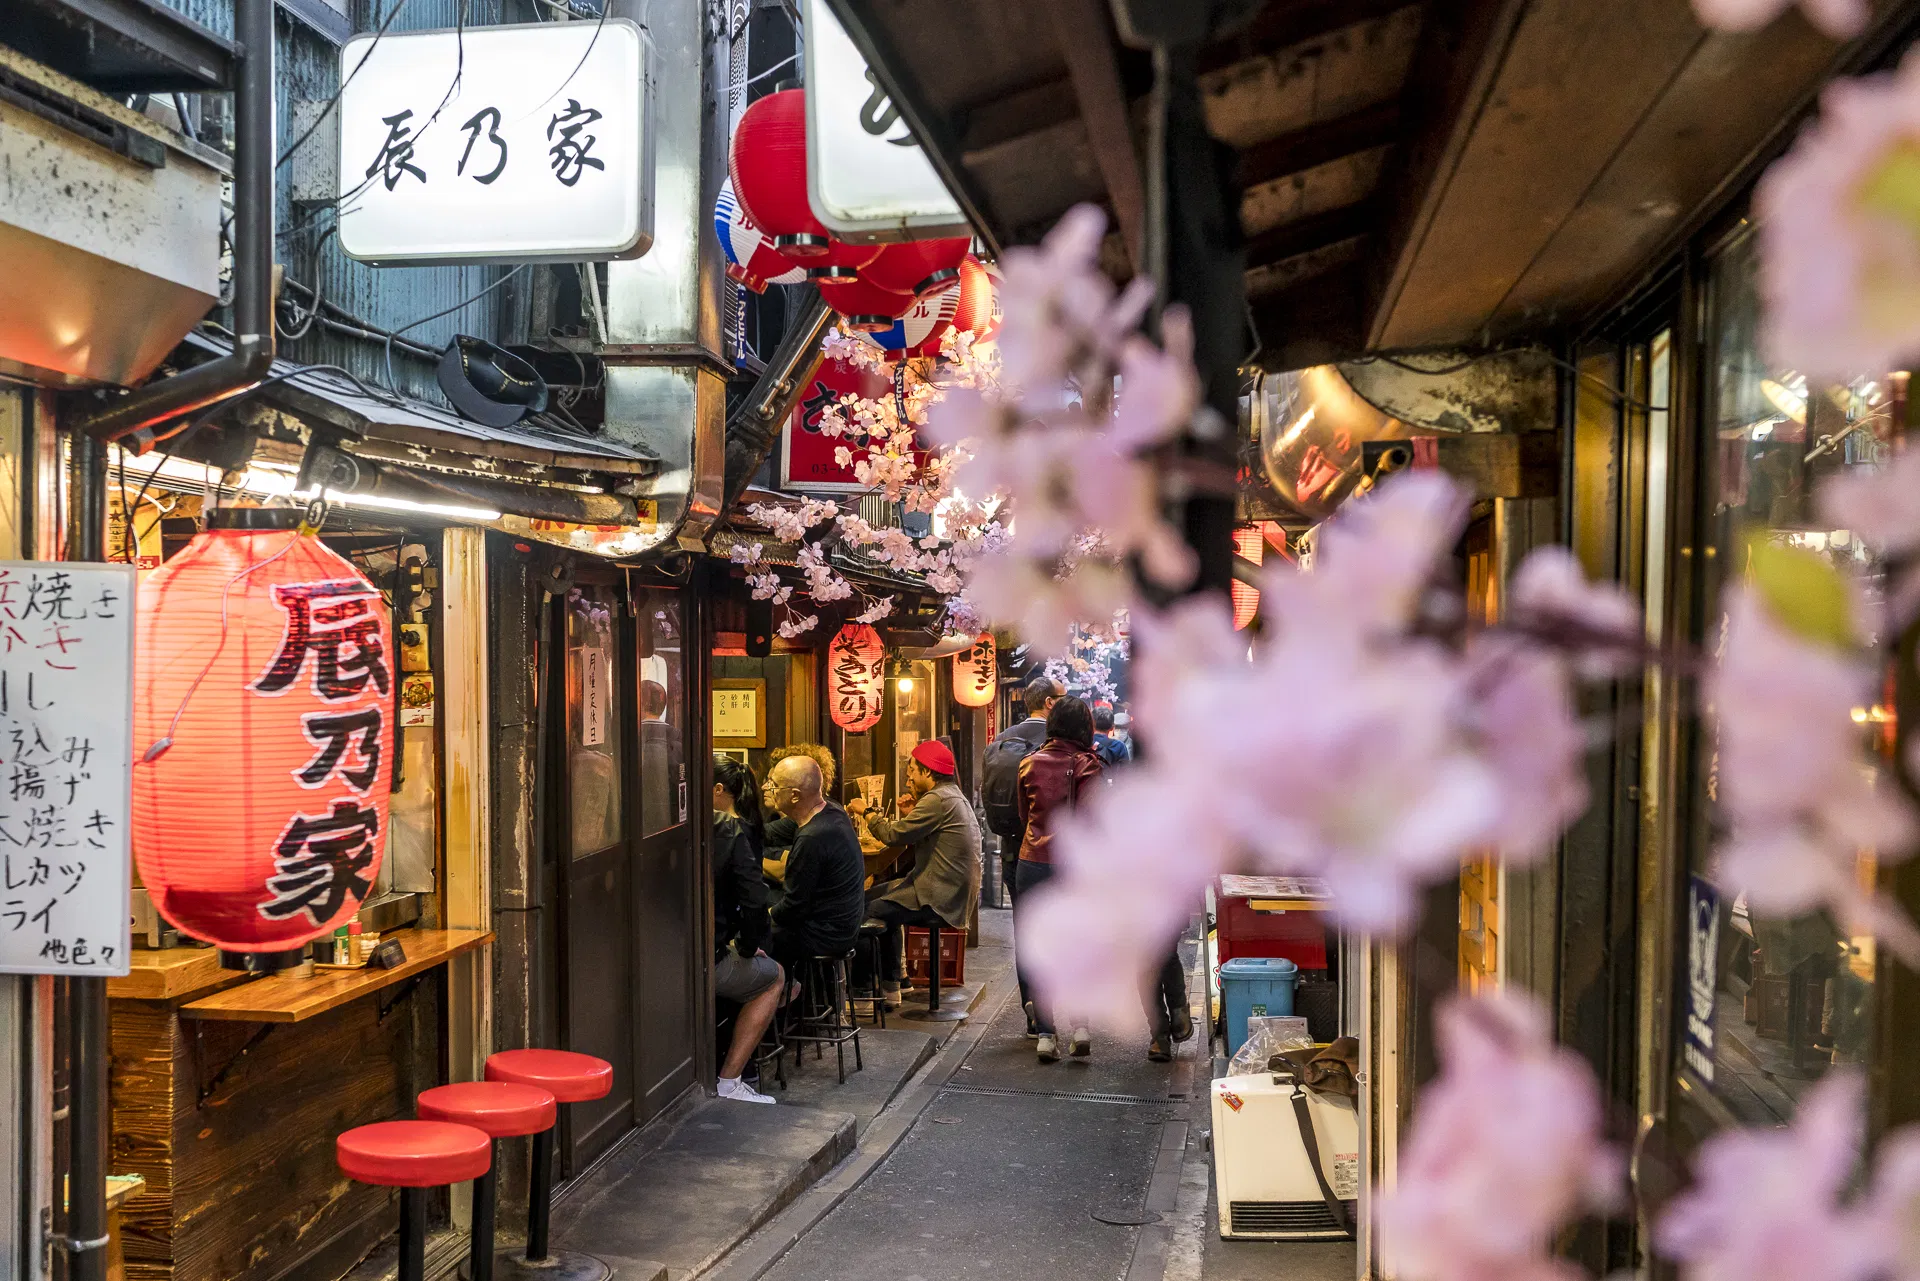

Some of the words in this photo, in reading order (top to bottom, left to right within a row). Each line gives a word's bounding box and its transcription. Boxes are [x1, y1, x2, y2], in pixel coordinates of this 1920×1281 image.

[366, 98, 605, 191] 辰乃家
[731, 694, 738, 709] 砂肝
[742, 694, 750, 709] 精肉
[245, 578, 391, 926] 辰乃家
[9, 766, 91, 805] 揚げ
[2, 898, 58, 934] ライ
[39, 937, 115, 966] 他色々
